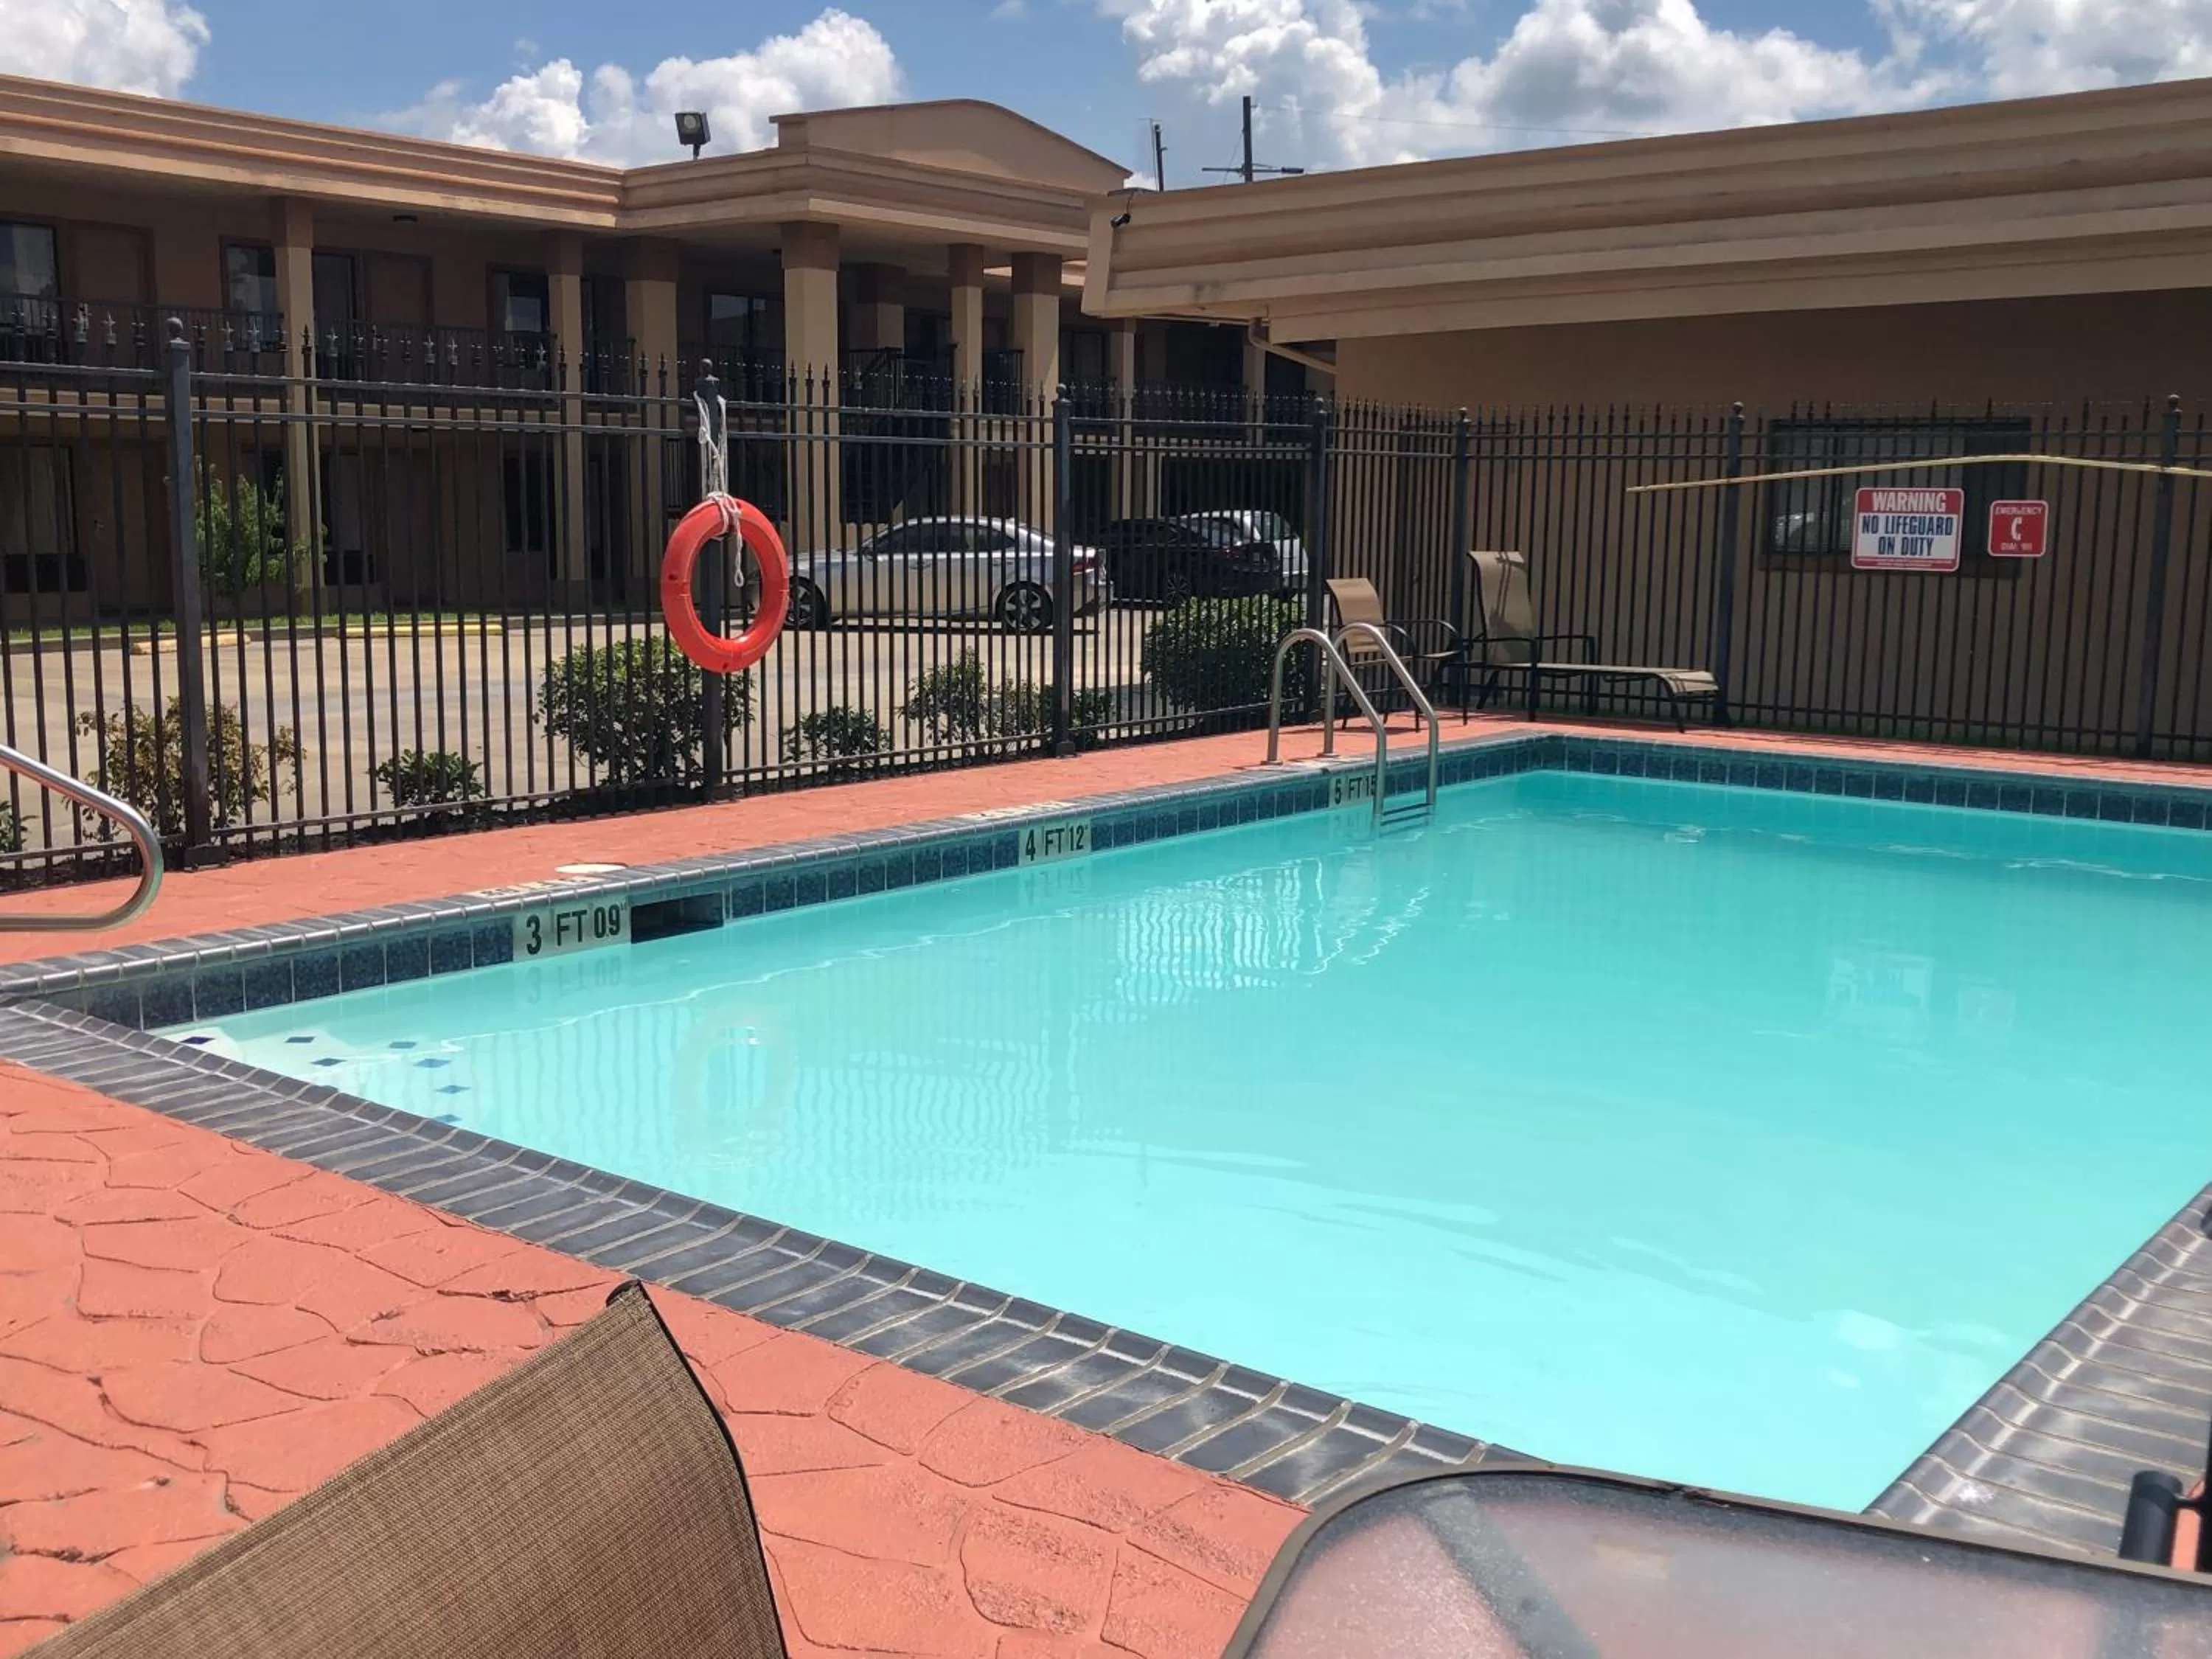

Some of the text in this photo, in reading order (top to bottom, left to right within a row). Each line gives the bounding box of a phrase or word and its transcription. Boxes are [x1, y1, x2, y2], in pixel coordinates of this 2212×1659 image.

[1872, 492, 1947, 512] WARNING
[1862, 515, 1953, 536] NO LIFEGUARD
[1878, 536, 1934, 557] ON DUTY
[1335, 779, 1342, 804] 5
[1348, 776, 1363, 800] FT
[1026, 829, 1036, 861] 4
[1045, 827, 1065, 856] FT
[526, 914, 542, 955] 3
[557, 909, 588, 946] FT
